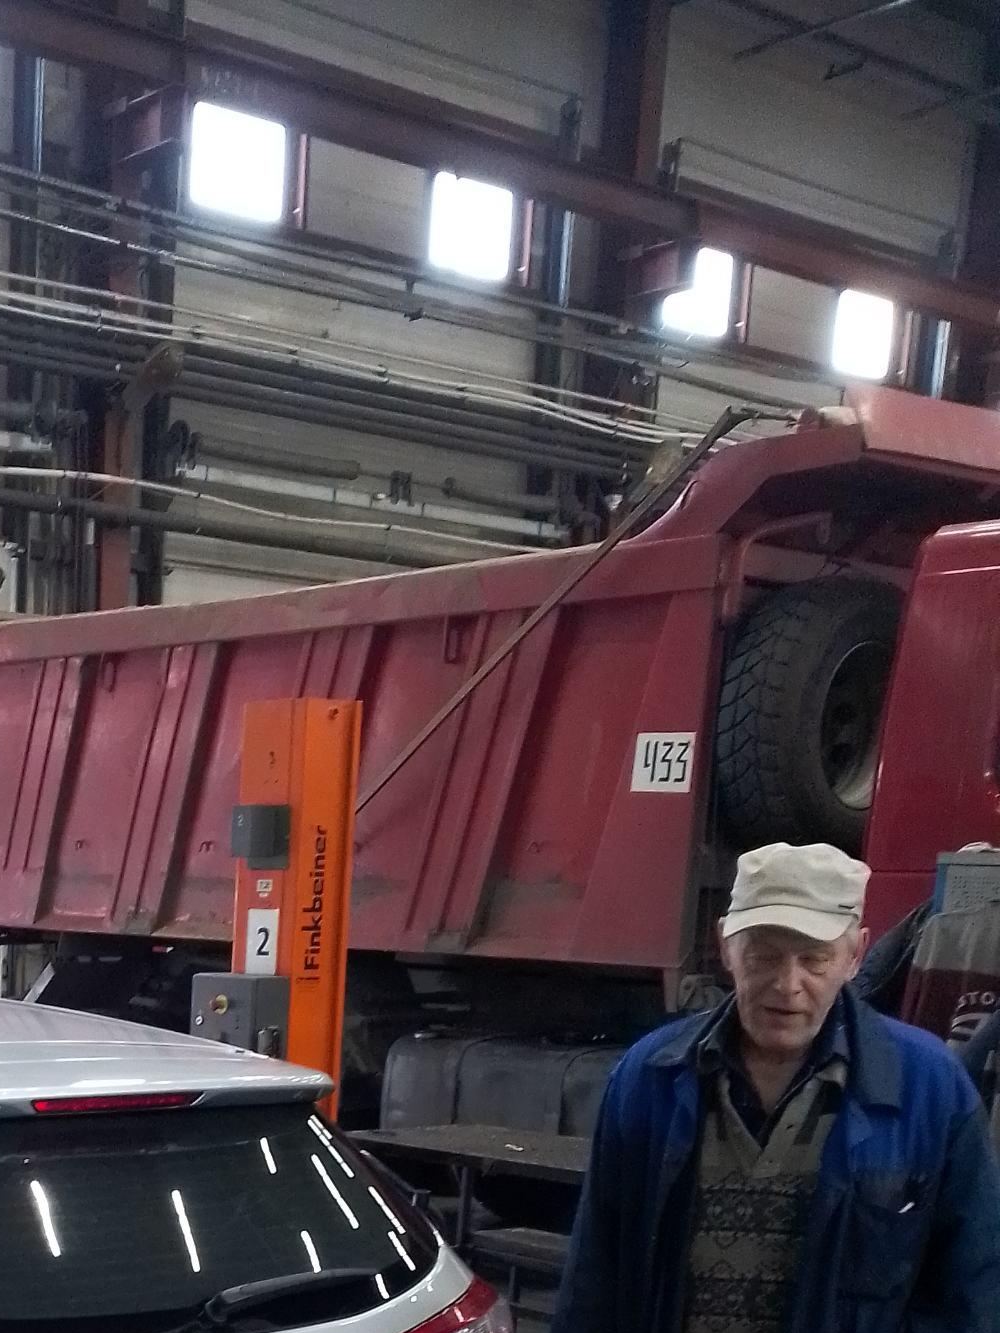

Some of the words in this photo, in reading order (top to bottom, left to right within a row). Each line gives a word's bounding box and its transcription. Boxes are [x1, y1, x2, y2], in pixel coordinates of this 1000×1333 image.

[643, 740, 690, 783] 433
[302, 825, 329, 971] Finkbeiner
[255, 927, 270, 956] 2
